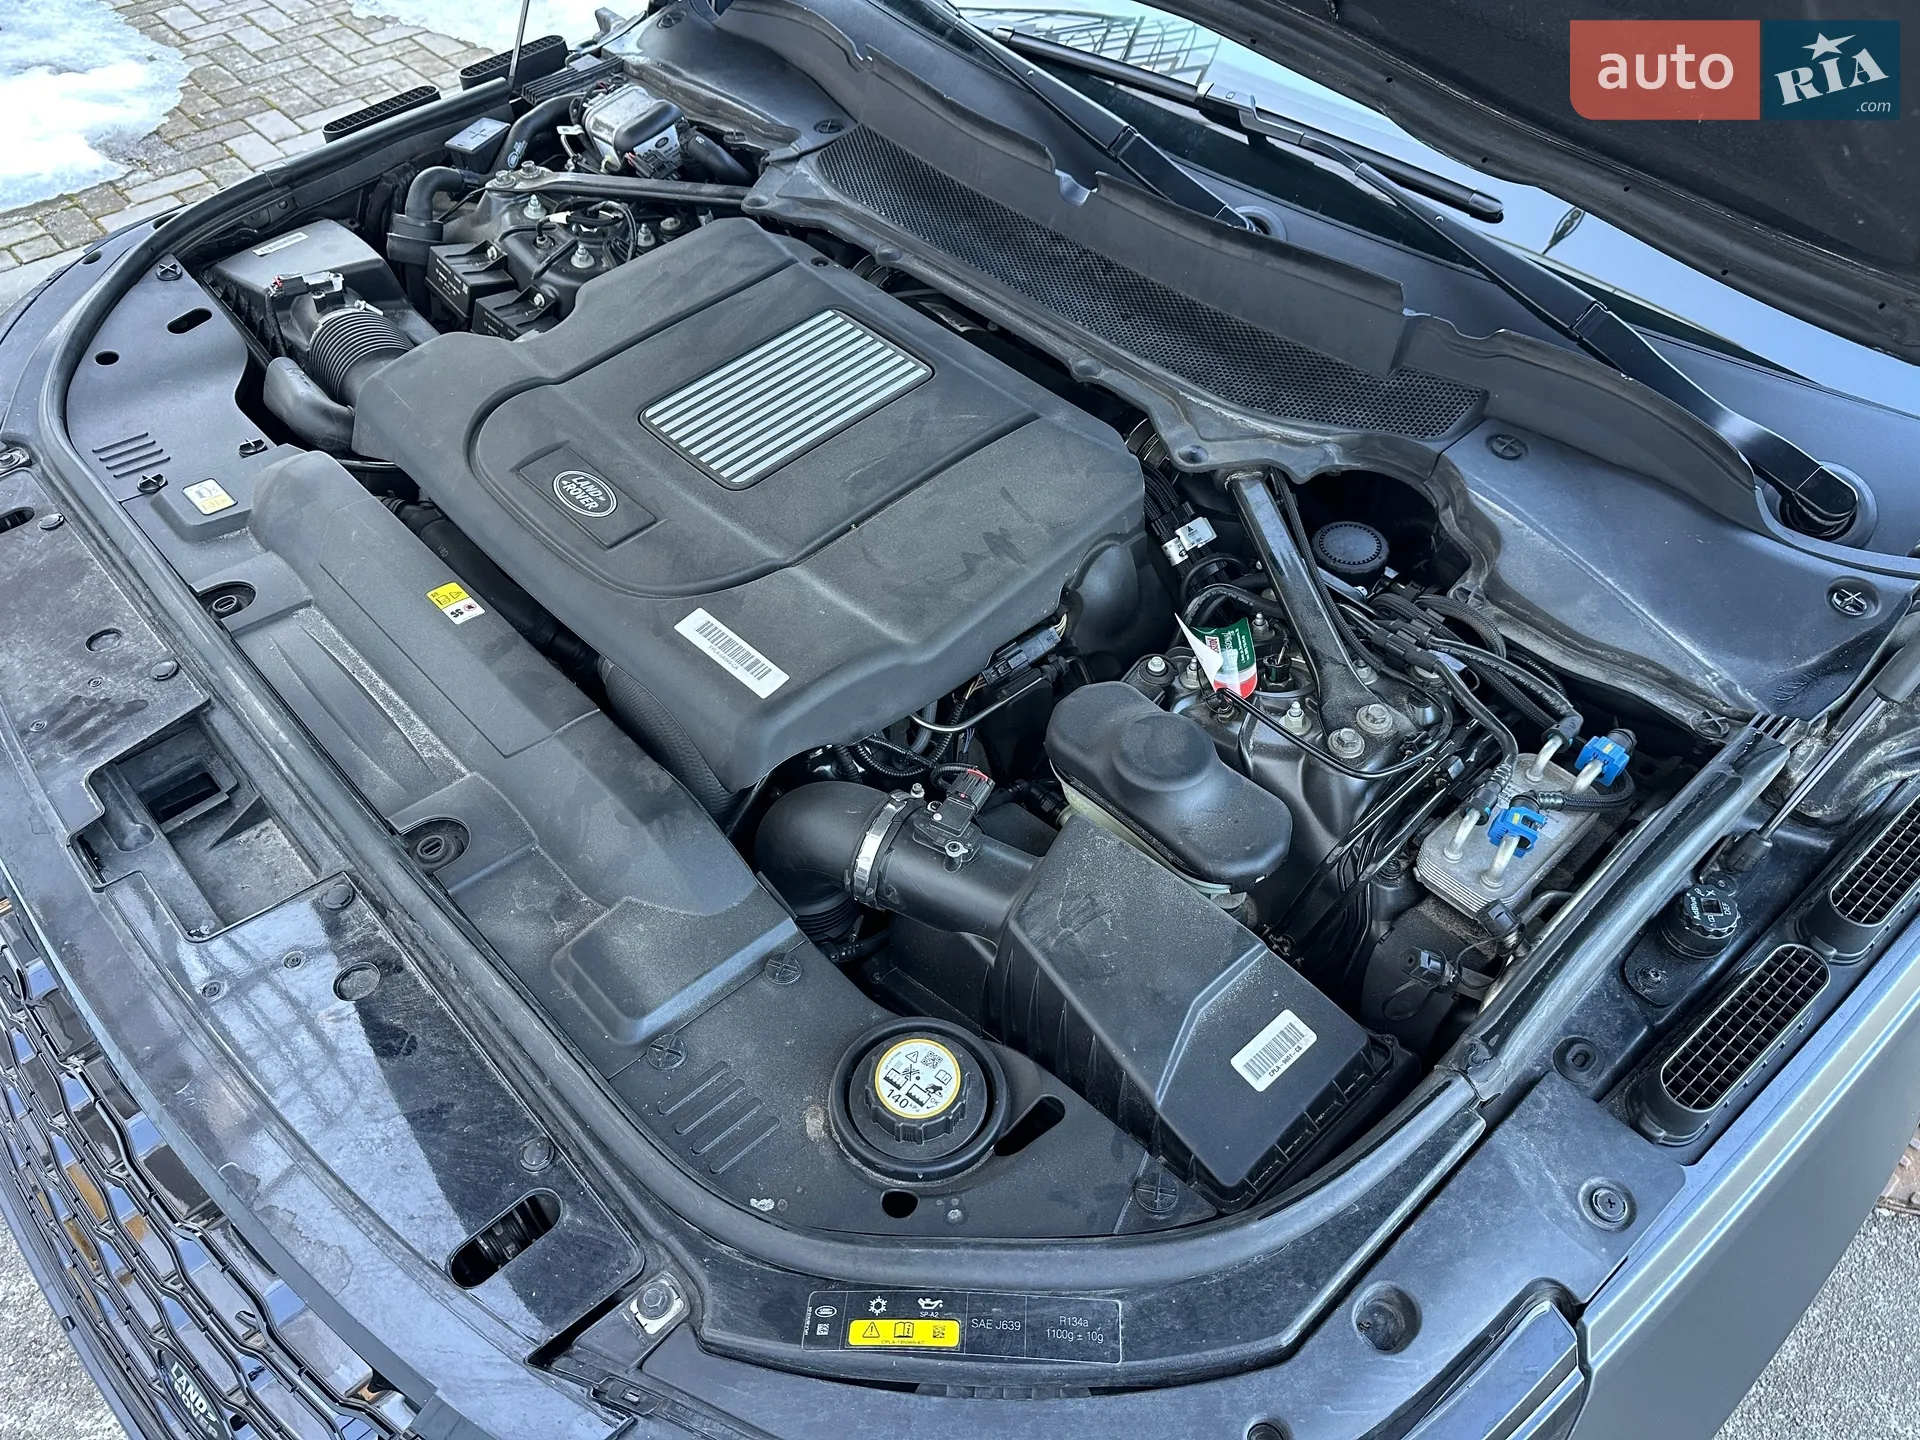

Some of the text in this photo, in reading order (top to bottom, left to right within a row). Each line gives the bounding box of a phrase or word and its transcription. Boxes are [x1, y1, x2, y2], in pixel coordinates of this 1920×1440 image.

[572, 476, 602, 498] LAND
[562, 482, 599, 510] ROVER
[1722, 902, 1732, 915] DEF
[887, 1089, 909, 1108] 140
[930, 1097, 940, 1106] OK
[971, 1319, 1021, 1331] SAE J639
[1060, 1316, 1089, 1327] R134a
[1046, 1328, 1074, 1342] 1100g
[1086, 1331, 1104, 1344] 10g
[171, 1361, 207, 1414] LAND
